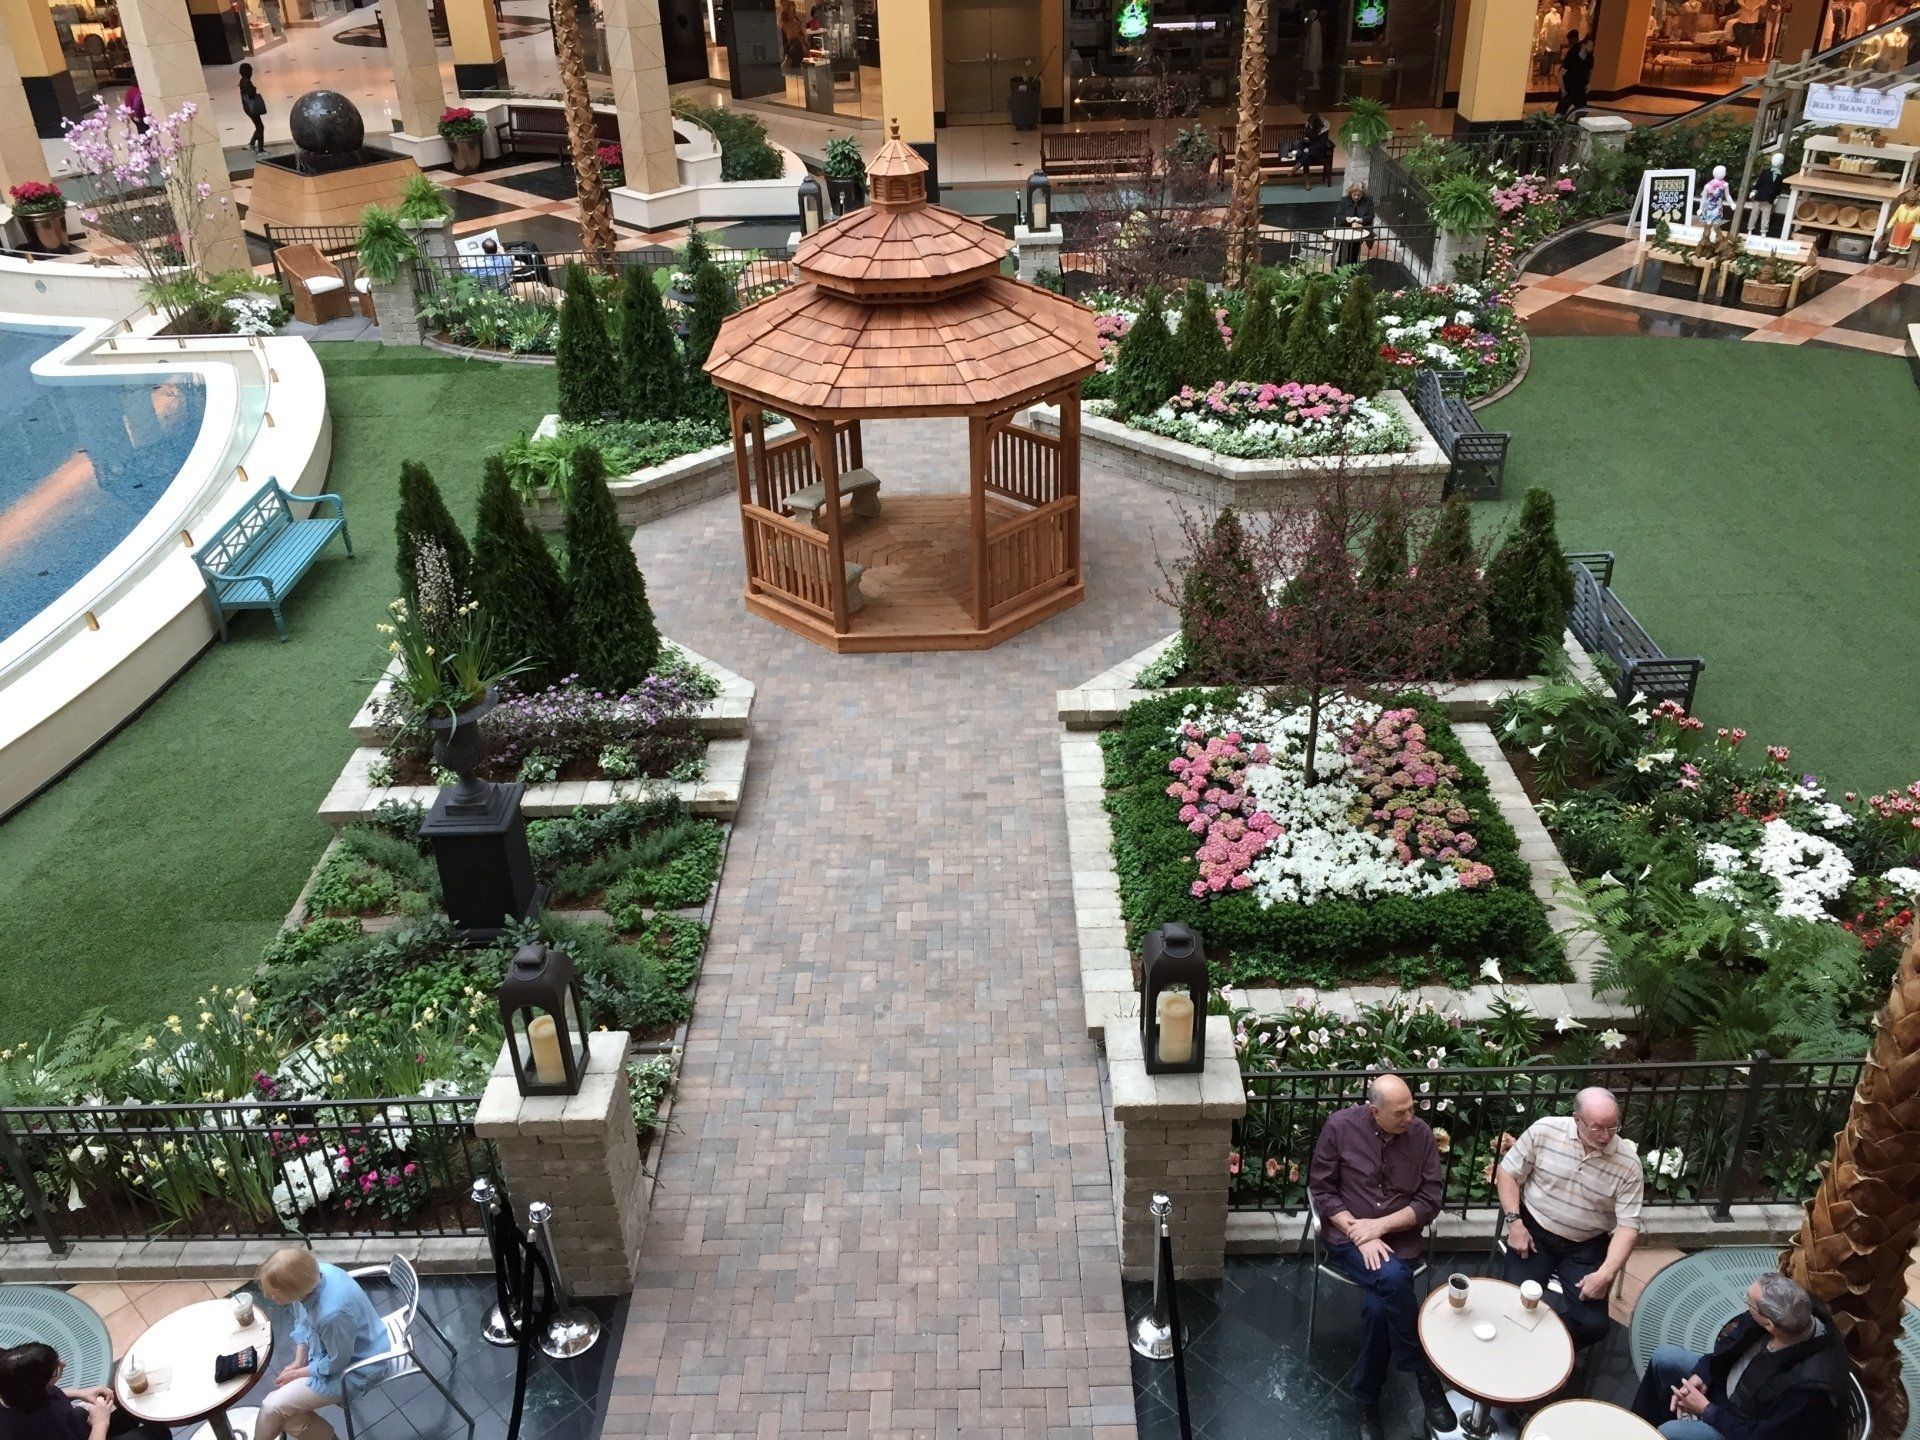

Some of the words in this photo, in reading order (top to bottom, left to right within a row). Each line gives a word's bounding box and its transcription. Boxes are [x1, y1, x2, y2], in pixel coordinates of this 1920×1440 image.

[1830, 93, 1868, 104] WELCOME
[1839, 103, 1862, 112] BEAN
[1865, 105, 1896, 116] FARMS
[1655, 180, 1683, 191] FRESH
[1658, 191, 1679, 203] EGGS
